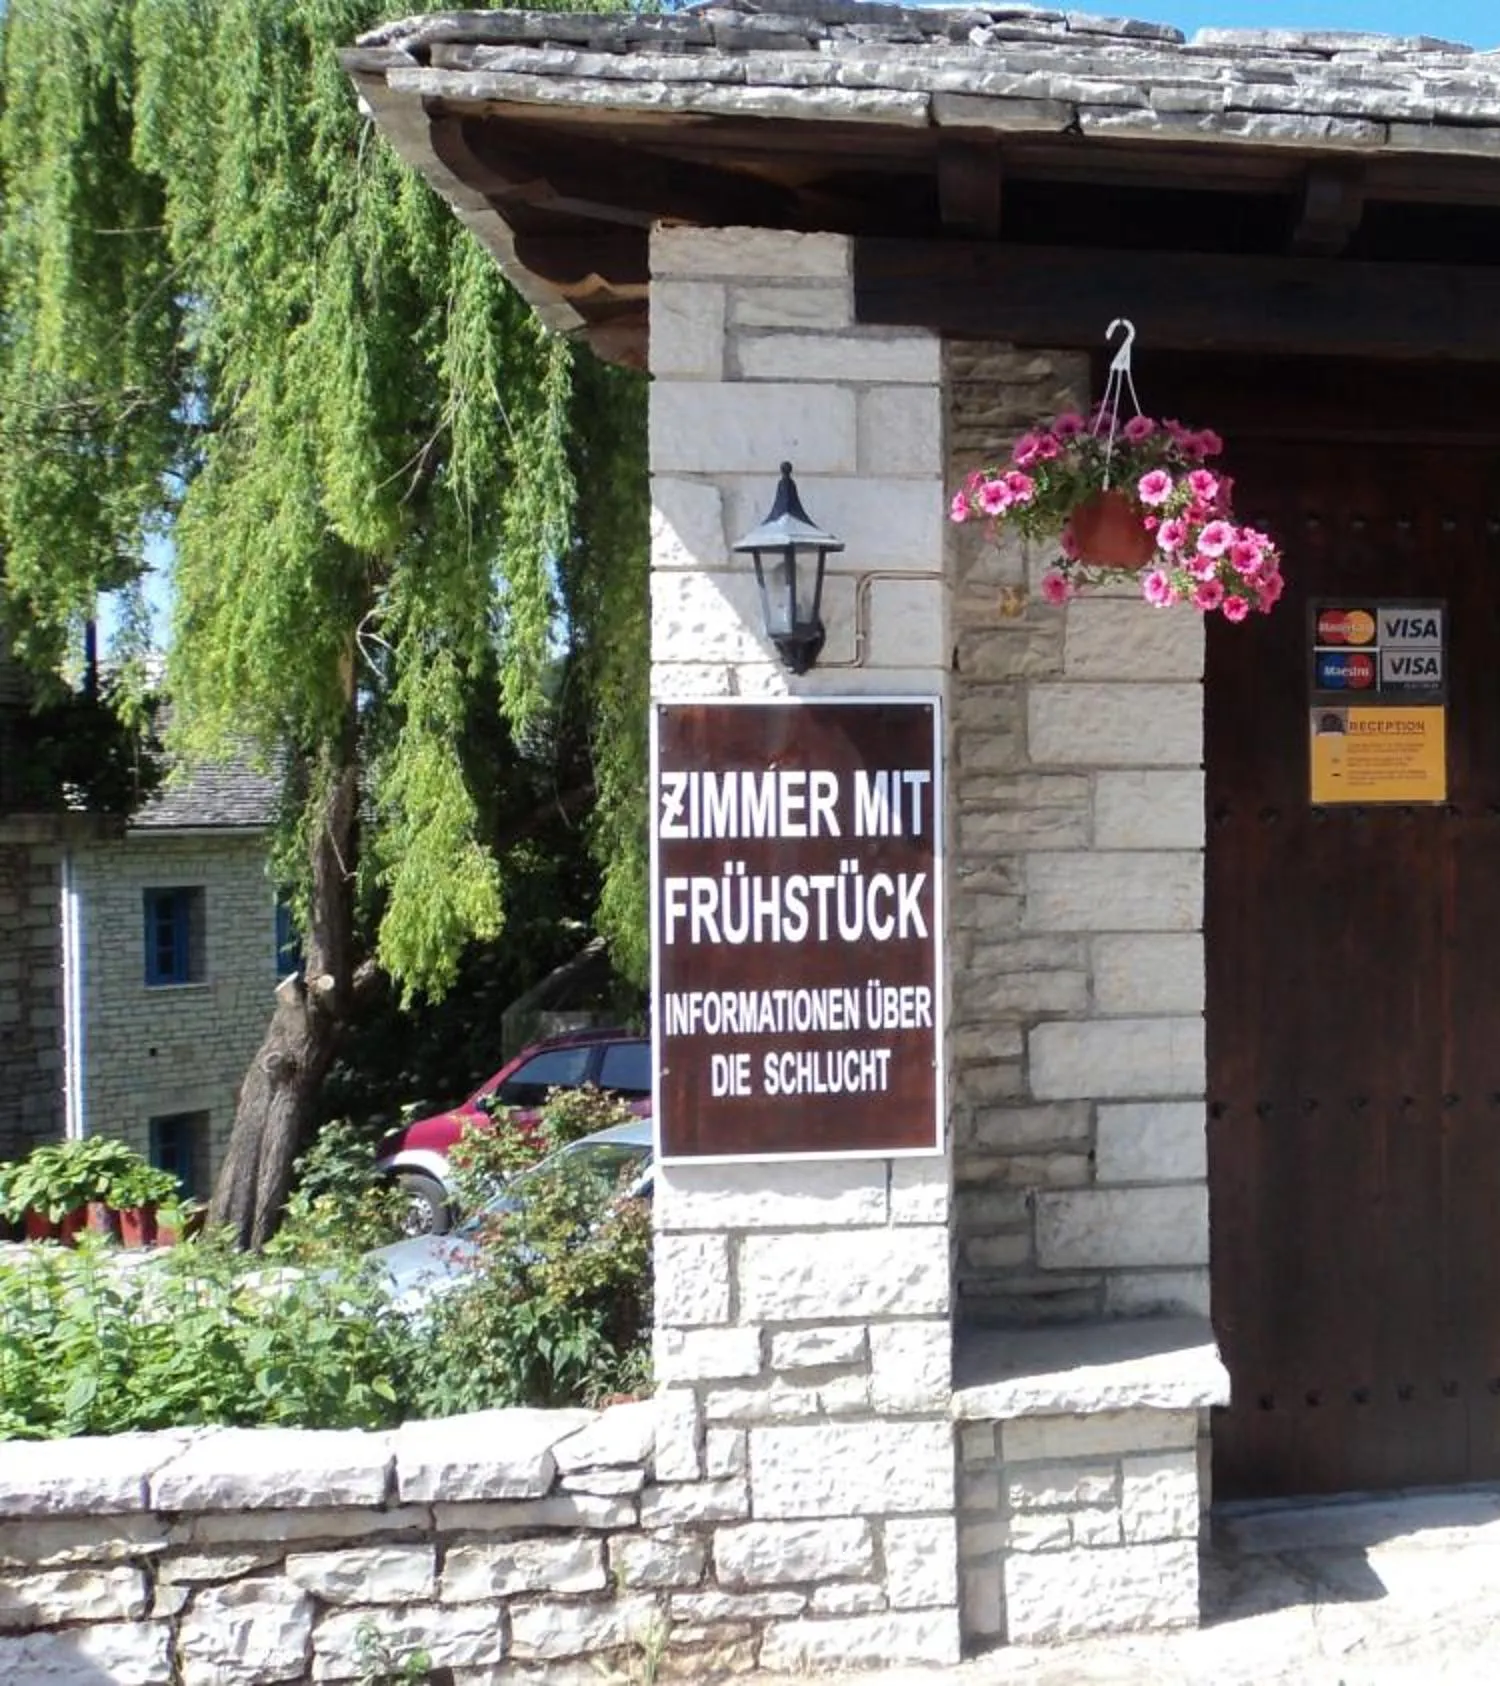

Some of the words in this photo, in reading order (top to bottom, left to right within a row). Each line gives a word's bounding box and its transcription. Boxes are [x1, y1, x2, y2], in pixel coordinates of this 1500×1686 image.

[1385, 618, 1438, 638] VISA
[1323, 665, 1369, 677] Maestro
[1391, 657, 1438, 675] VISA
[1349, 720, 1425, 731] RECEPTION
[659, 770, 841, 839] ZIMMER
[854, 769, 931, 836] MIT
[663, 858, 929, 945] FRÜHSTÜCK
[665, 988, 860, 1036] INFORMATIONEN
[866, 980, 933, 1030] ÜBER
[711, 1053, 752, 1097] DIE
[763, 1049, 891, 1096] SCHLUCHT
